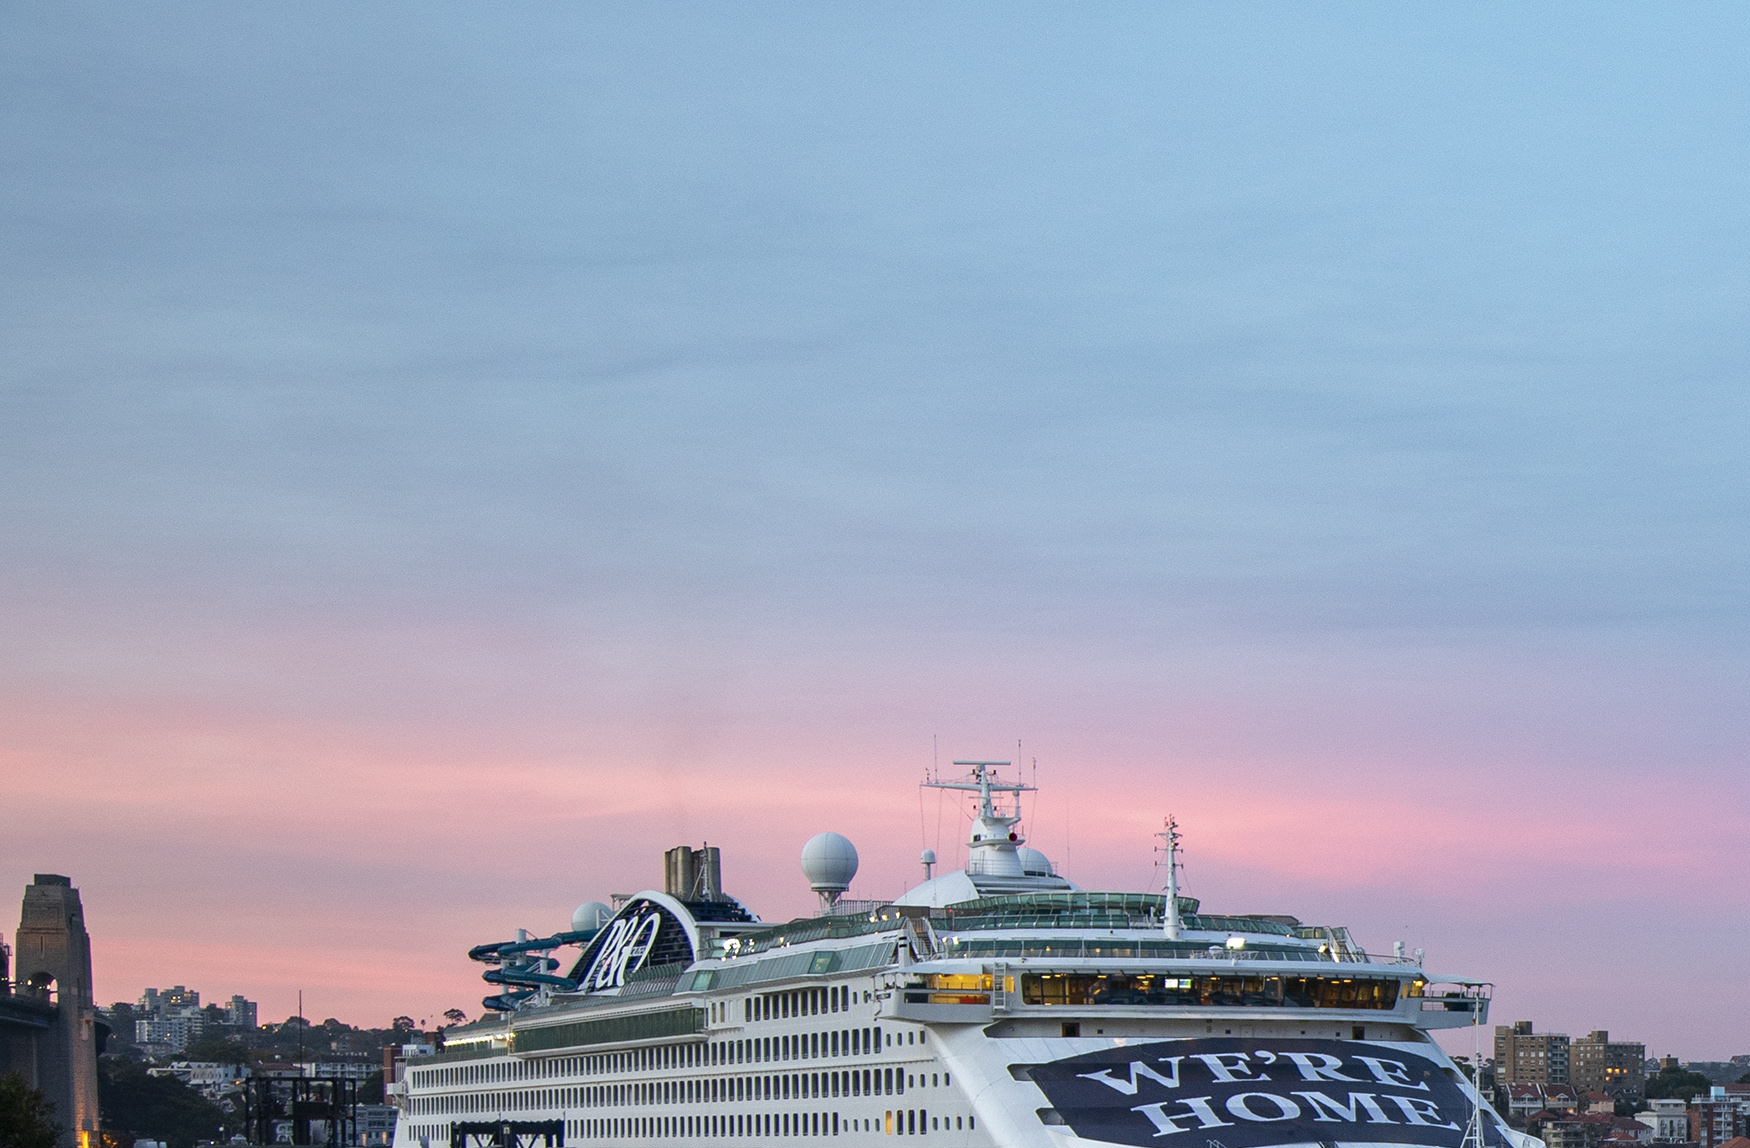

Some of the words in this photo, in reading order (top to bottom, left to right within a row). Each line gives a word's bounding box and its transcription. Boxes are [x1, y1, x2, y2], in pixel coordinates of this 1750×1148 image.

[577, 912, 661, 991] P&O
[1076, 1050, 1430, 1096] WE'RE
[1130, 1091, 1461, 1138] HOME
